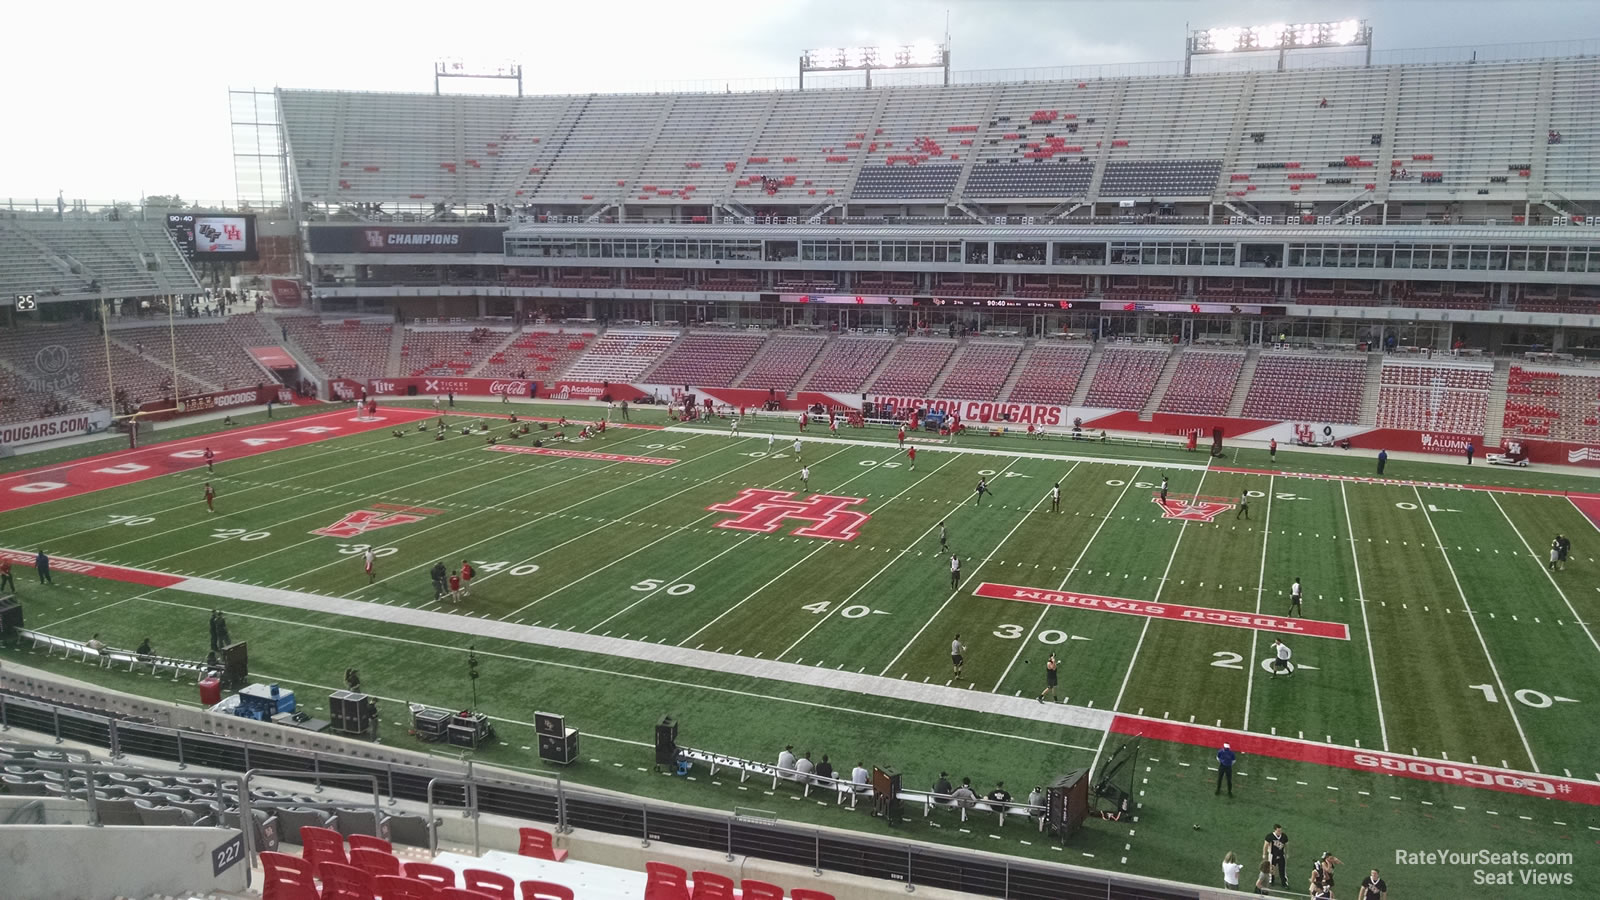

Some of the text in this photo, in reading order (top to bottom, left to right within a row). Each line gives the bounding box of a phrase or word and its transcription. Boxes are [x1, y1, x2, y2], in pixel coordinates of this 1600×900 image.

[199, 223, 222, 243] UCF
[387, 233, 460, 245] CHAMPIONS
[18, 295, 35, 309] 25
[26, 371, 80, 393] Allstate
[371, 380, 395, 394] Lite
[571, 385, 605, 396] Academy
[965, 401, 1062, 425] COUGARS
[1295, 424, 1314, 443] UH
[1434, 434, 1472, 442] HOUSTON
[1432, 438, 1470, 451] ALUMN
[1013, 588, 1304, 631] TDECU STADIUM
[1354, 754, 1573, 795] #GOCOOGS
[218, 841, 241, 868] 227
